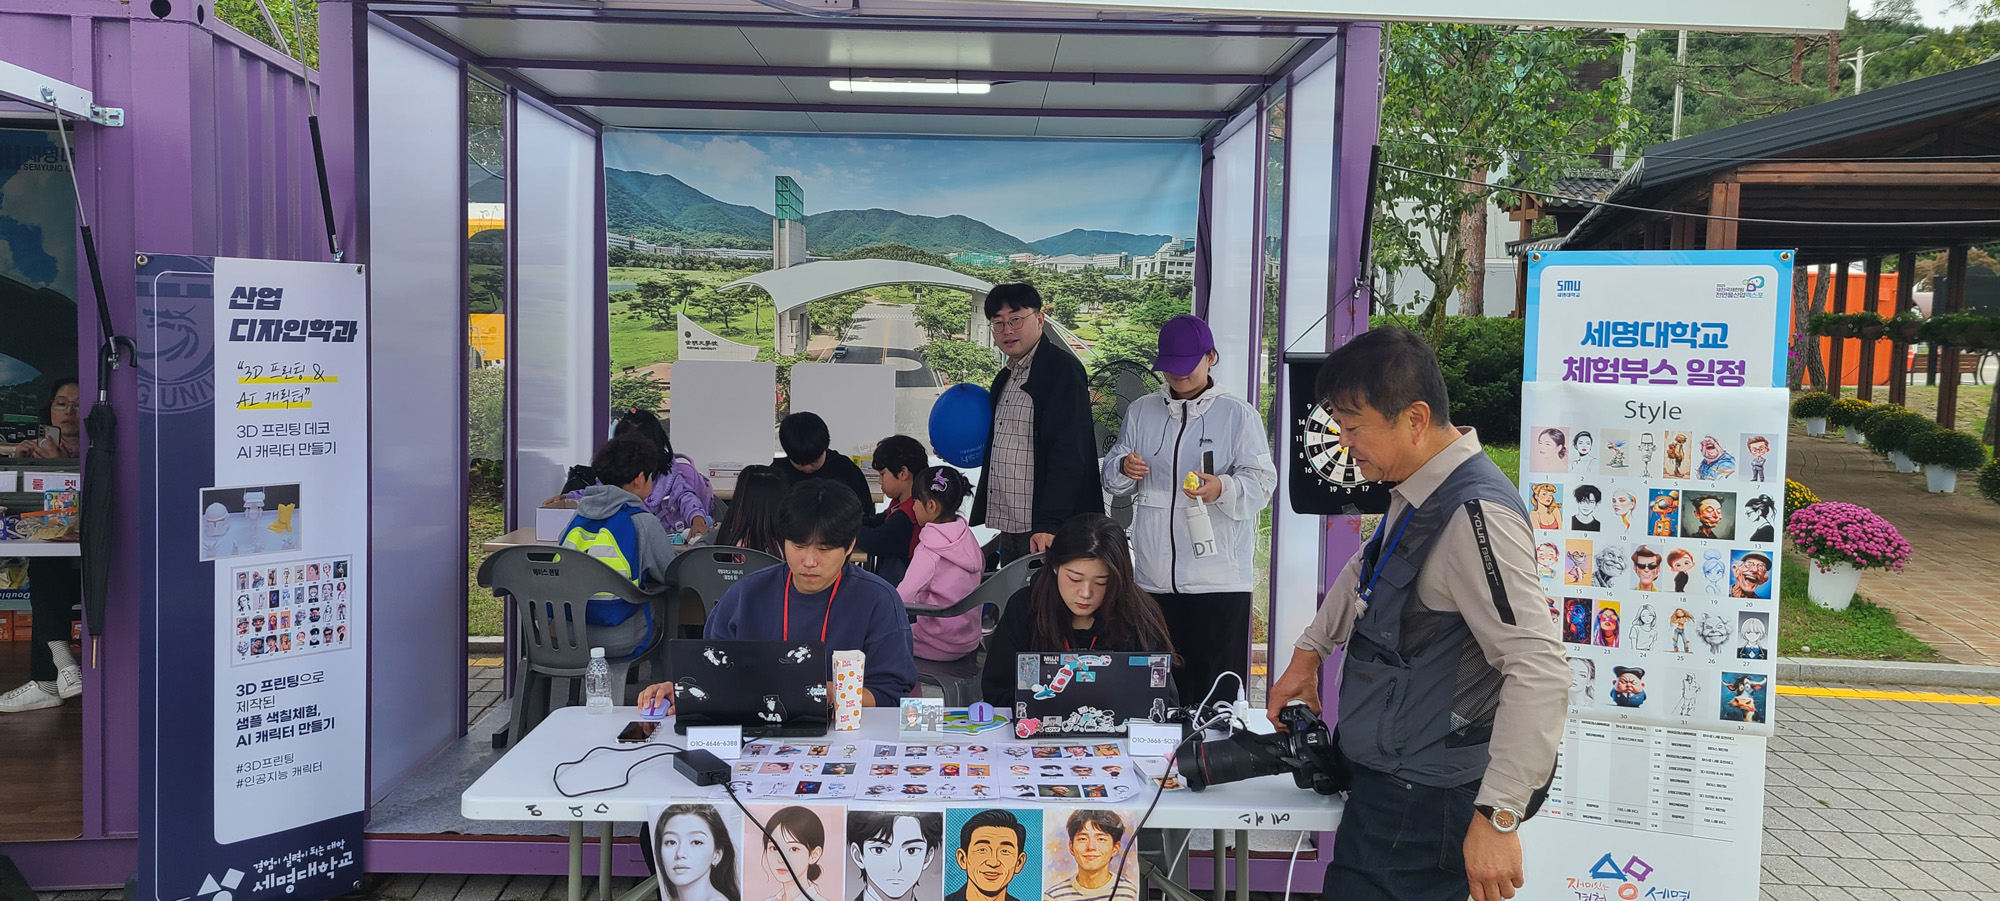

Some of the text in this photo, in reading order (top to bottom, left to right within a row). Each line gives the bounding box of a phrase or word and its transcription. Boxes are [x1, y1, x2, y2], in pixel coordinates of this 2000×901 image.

[23, 164, 63, 172] SEMYUNG
[229, 286, 283, 310] 산업
[1557, 281, 1581, 291] SMU
[229, 318, 358, 342] 디자인학과
[1580, 321, 1729, 349] 세명대학교
[270, 362, 305, 380] 프린팅
[313, 363, 325, 382] &
[1562, 356, 1746, 387] 체험부스 일정
[236, 392, 260, 408] AI
[1624, 400, 1682, 424] Style
[237, 422, 330, 438] 3D 프린팅 데코
[237, 442, 336, 459] AI 캐릭터 만들기
[1473, 512, 1486, 544] YOUR
[1481, 546, 1494, 575] BEST
[236, 670, 324, 697] 3D 프린팅으로
[236, 695, 275, 713] 제작된
[236, 704, 321, 730] 샘플 색칠체험,
[236, 717, 335, 748] AI 캐릭터 만들기
[236, 753, 294, 774] #3D프린팅
[236, 761, 323, 789] #인공지능 캐릭터
[253, 839, 345, 873] 경험이 실력이 되는 대학
[252, 851, 353, 893] 세명대학교
[1566, 878, 1608, 890] 재미있는
